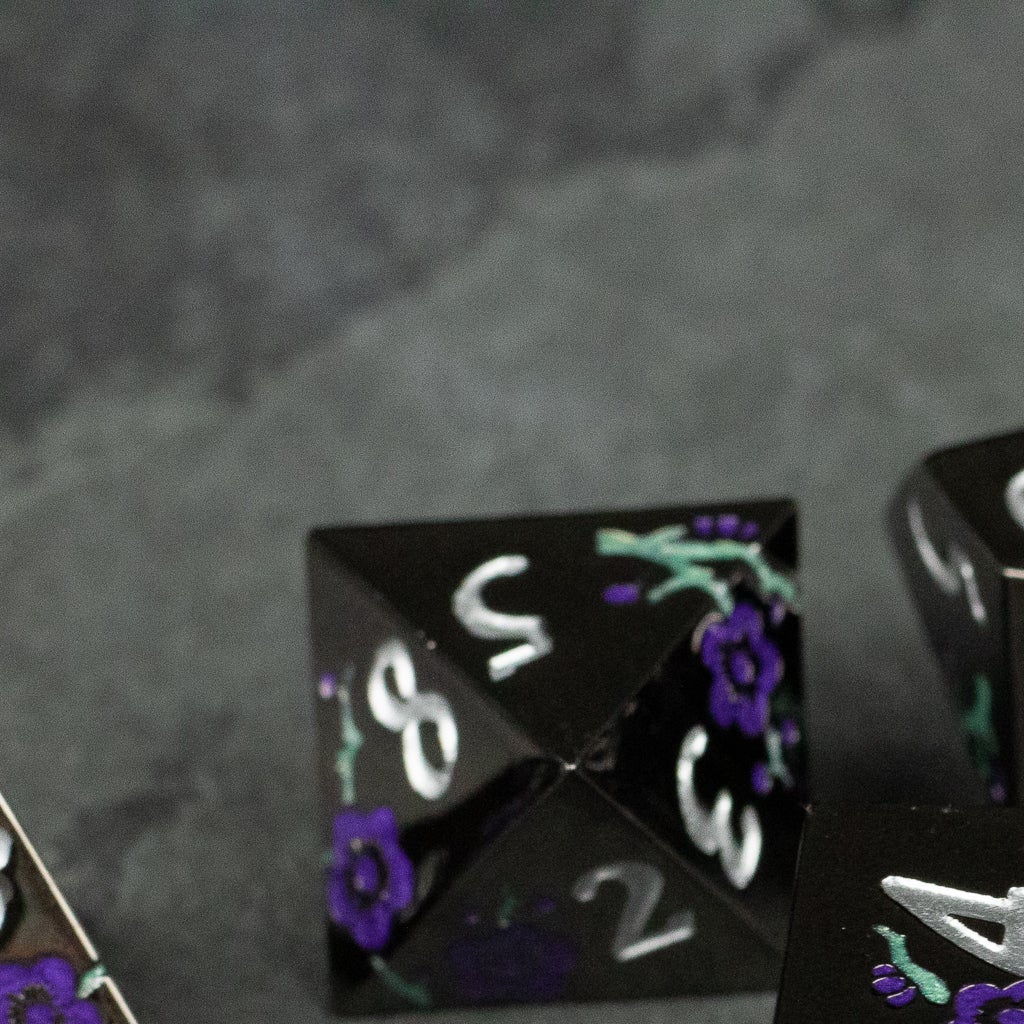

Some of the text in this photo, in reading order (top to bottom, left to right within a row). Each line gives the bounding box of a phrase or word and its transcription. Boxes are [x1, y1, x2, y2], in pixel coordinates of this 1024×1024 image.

[451, 553, 553, 681] 5
[366, 636, 458, 800] 8
[676, 724, 762, 891] 3
[573, 860, 696, 963] 2
